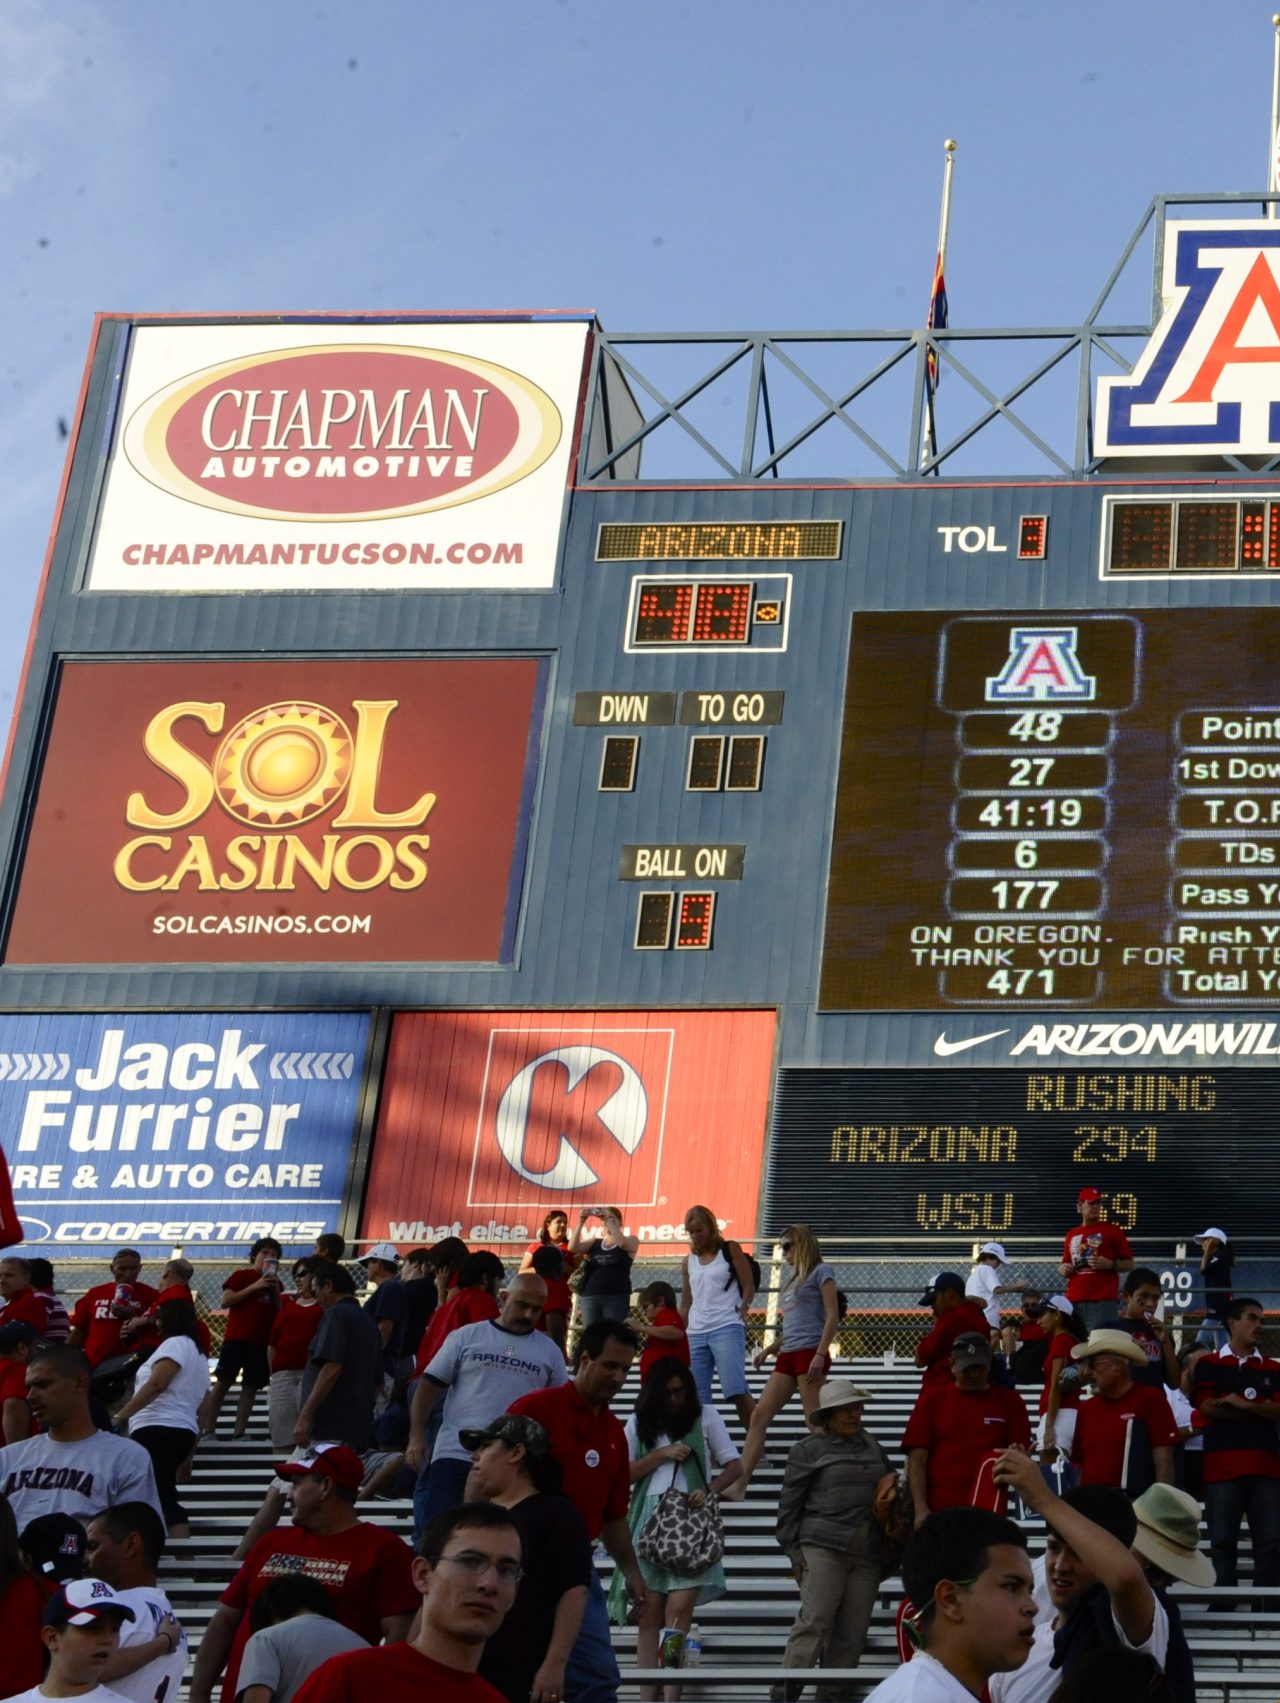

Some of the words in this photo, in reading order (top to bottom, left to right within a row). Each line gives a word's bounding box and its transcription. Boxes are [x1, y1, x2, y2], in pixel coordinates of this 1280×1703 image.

[201, 388, 489, 452] CHAPMAN
[200, 456, 474, 478] AUTOMOTIVE
[639, 527, 800, 557] ARIZONA
[938, 526, 1007, 552] TOL
[1020, 519, 1044, 557] 3
[122, 543, 524, 565] CHAPMANTUCSON.COM
[640, 586, 751, 641] 48
[599, 696, 648, 722] DWN
[698, 695, 726, 722] TO
[733, 694, 765, 722] GO
[1008, 711, 1063, 742] 48
[126, 699, 436, 830] SOL
[1008, 758, 1055, 786] 27
[1179, 758, 1220, 779] 1st
[978, 799, 1082, 827] 41:19
[113, 834, 430, 891] CASINOS
[635, 849, 686, 877] BALL
[694, 849, 727, 877] ON
[1014, 840, 1037, 868] 6
[1220, 842, 1276, 863] TDs
[991, 881, 1059, 910] 177
[1182, 884, 1249, 905] Pass
[152, 915, 371, 934] SOLCASINOS.COM
[679, 896, 712, 944] 9
[911, 926, 952, 943] ON
[974, 926, 1114, 943] OREGON.
[1178, 926, 1252, 943] Rush
[911, 948, 1015, 966] THANK
[1038, 948, 1099, 966] YOU
[1122, 947, 1185, 965] FOR
[987, 969, 1055, 995] 471
[1177, 969, 1248, 991] Total
[75, 1029, 267, 1091] Jack
[1026, 1075, 1217, 1112] RUSHING
[18, 1089, 300, 1152] Furrier
[830, 1126, 1018, 1162] ARIZONA
[1073, 1126, 1157, 1162] 294
[72, 1164, 99, 1189] &
[111, 1164, 214, 1188] AUTO
[224, 1163, 324, 1188] CARE
[916, 1193, 1014, 1230] WSU
[1100, 1193, 1138, 1230] 9
[389, 1220, 463, 1241] What
[470, 1219, 529, 1241] else
[473, 1353, 541, 1376] ARIZONA
[5, 1467, 94, 1499] ARIZONA
